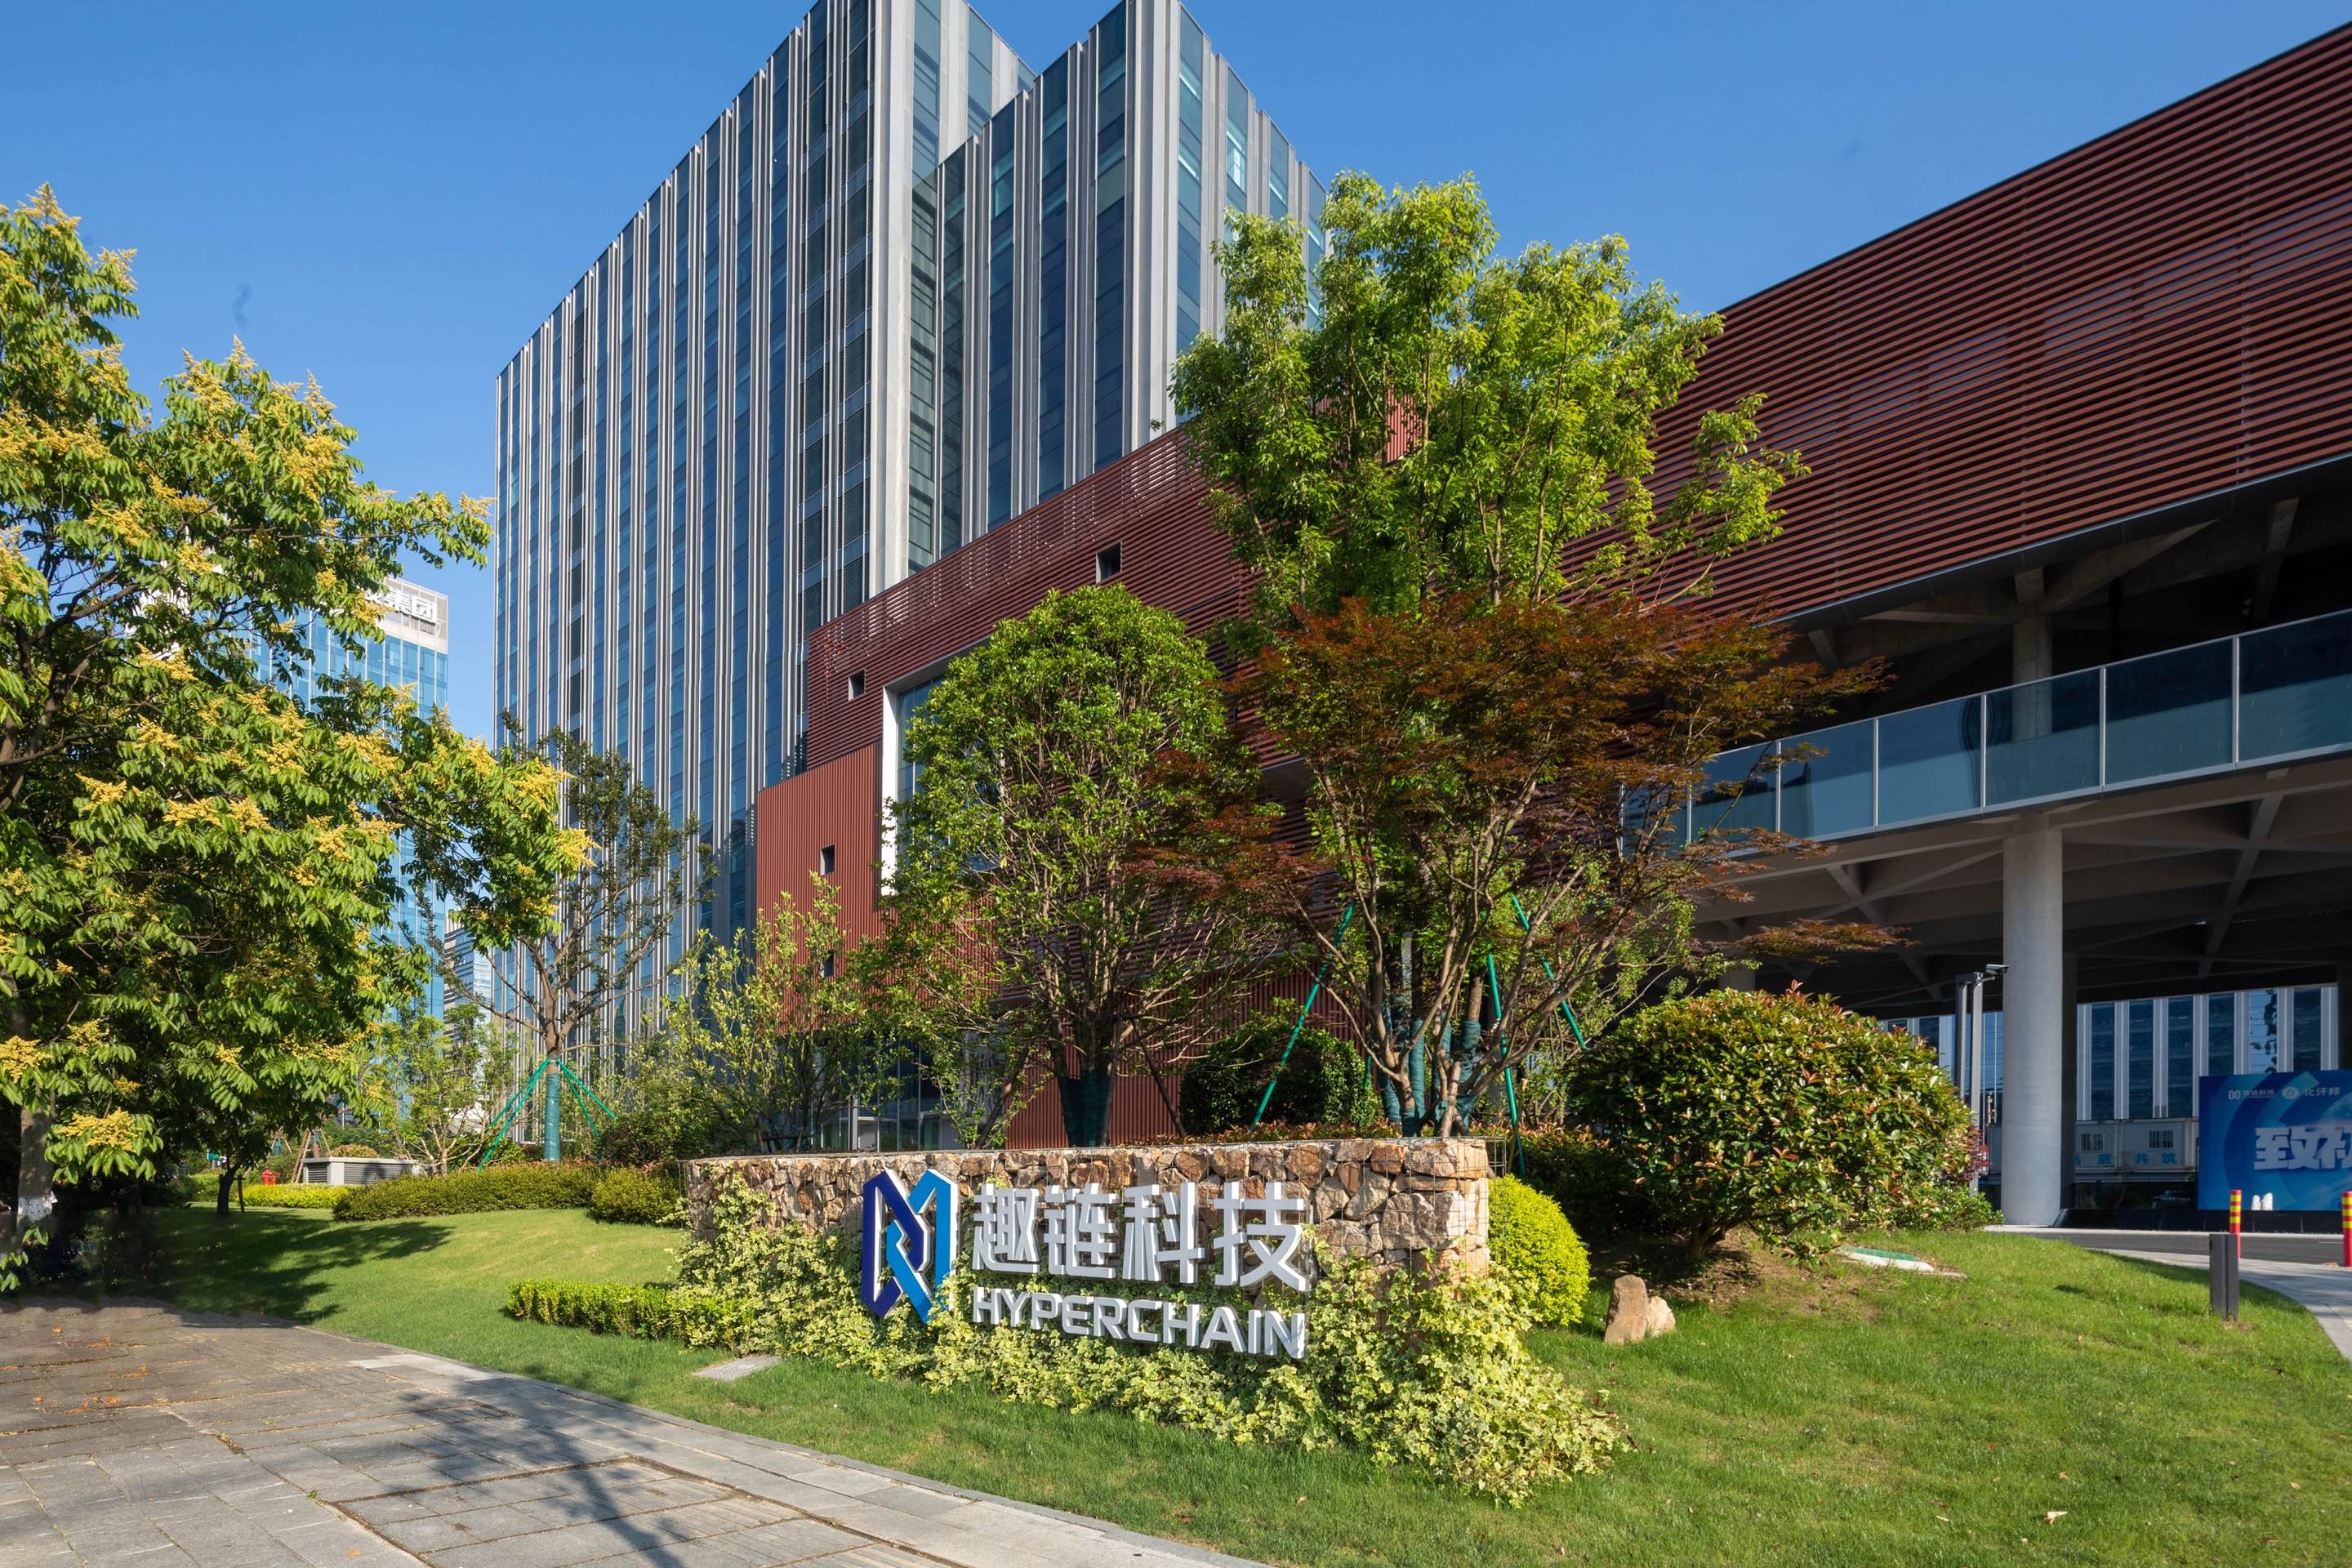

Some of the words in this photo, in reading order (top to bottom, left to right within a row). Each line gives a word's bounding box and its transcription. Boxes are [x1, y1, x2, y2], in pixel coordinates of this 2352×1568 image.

[971, 1181, 1312, 1293] 趣链科技
[972, 1285, 1307, 1360] HYPERCHAIN
